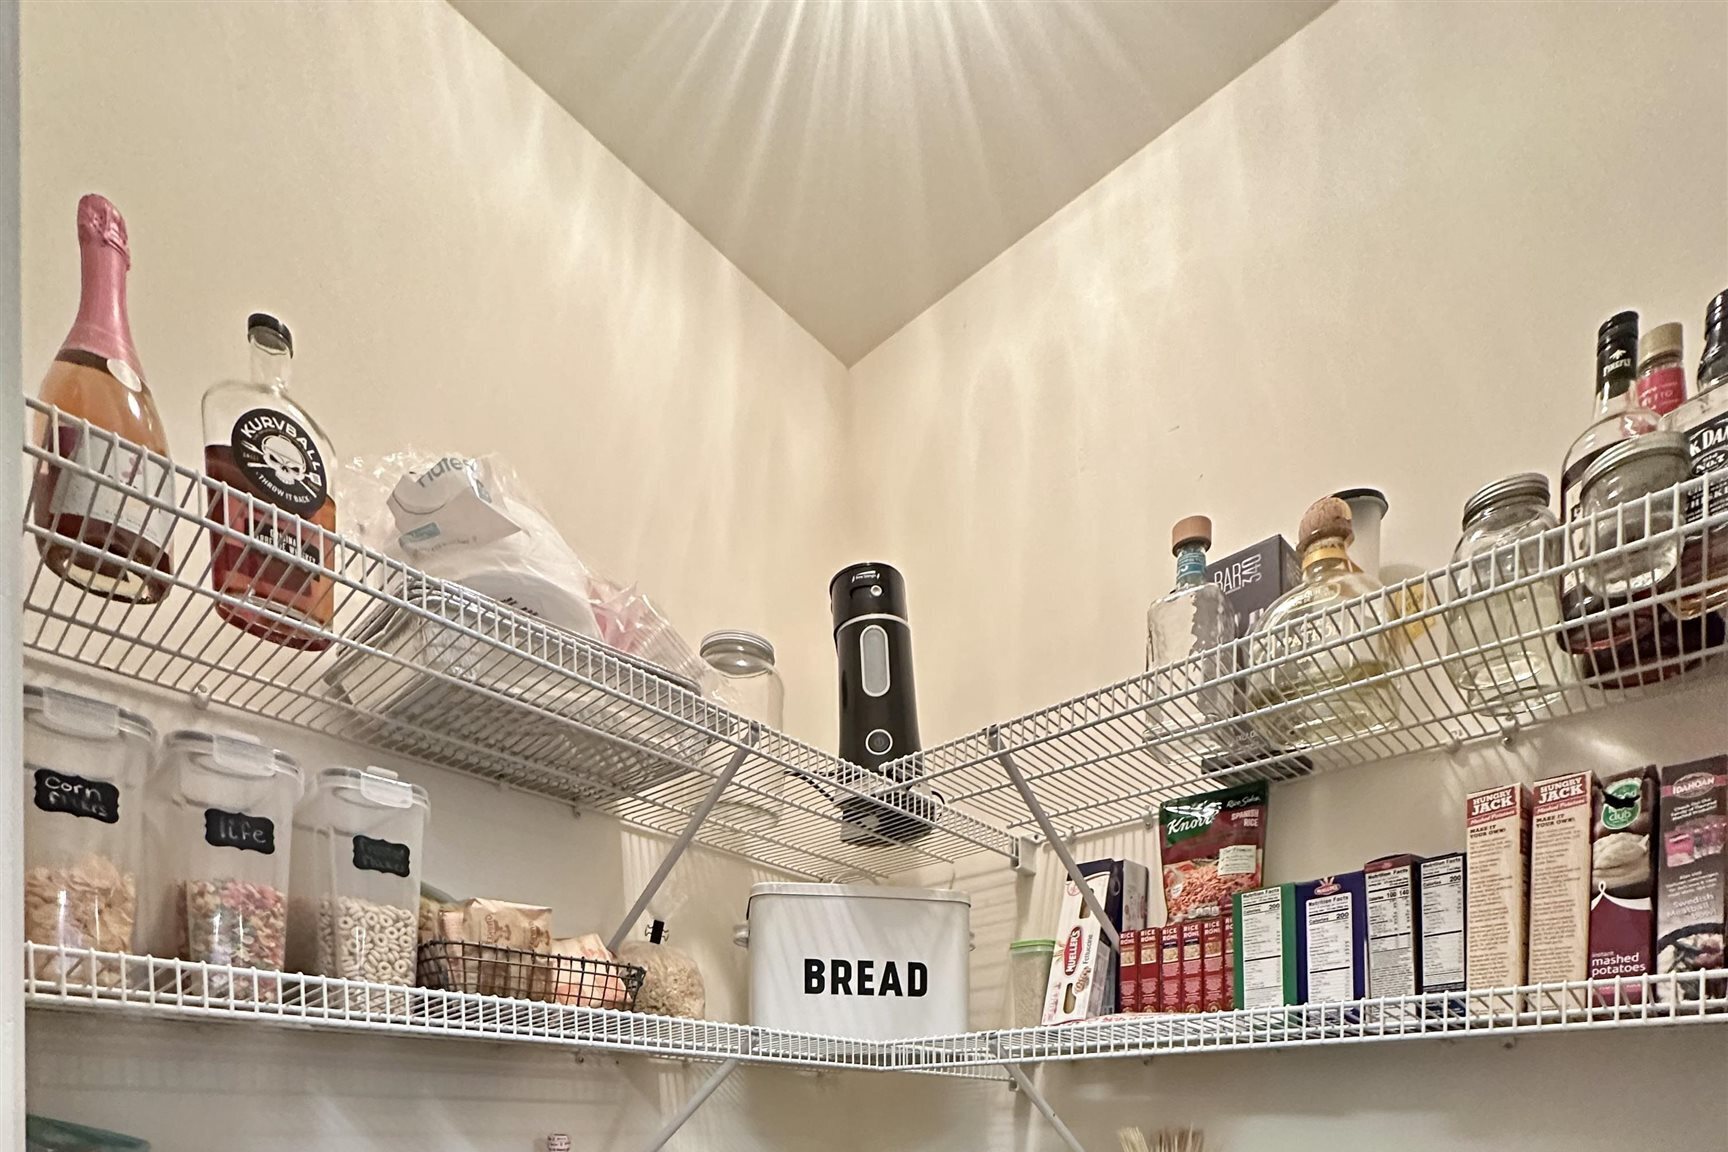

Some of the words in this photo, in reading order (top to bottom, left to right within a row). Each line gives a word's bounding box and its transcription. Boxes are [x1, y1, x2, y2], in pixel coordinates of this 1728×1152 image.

[240, 416, 323, 472] KURVBALL
[257, 473, 286, 497] THROW
[285, 493, 294, 502] IT
[1214, 562, 1242, 593] BAR
[1540, 777, 1583, 794] HUNGRY
[1671, 777, 1716, 796] IDAHOAN
[1472, 789, 1513, 806] HUNGRY
[1538, 784, 1585, 805] JACK
[1471, 796, 1515, 816] JACK
[1167, 816, 1213, 836] Knorr
[1243, 818, 1259, 827] RICE
[1204, 920, 1220, 929] RICE
[1335, 911, 1350, 921] 200
[1140, 929, 1156, 937] RICE
[1162, 927, 1178, 935] RICE
[1183, 924, 1199, 932] RICE
[1592, 952, 1640, 967] mashed
[804, 958, 928, 997] BREAD
[1592, 963, 1647, 978] potatoes
